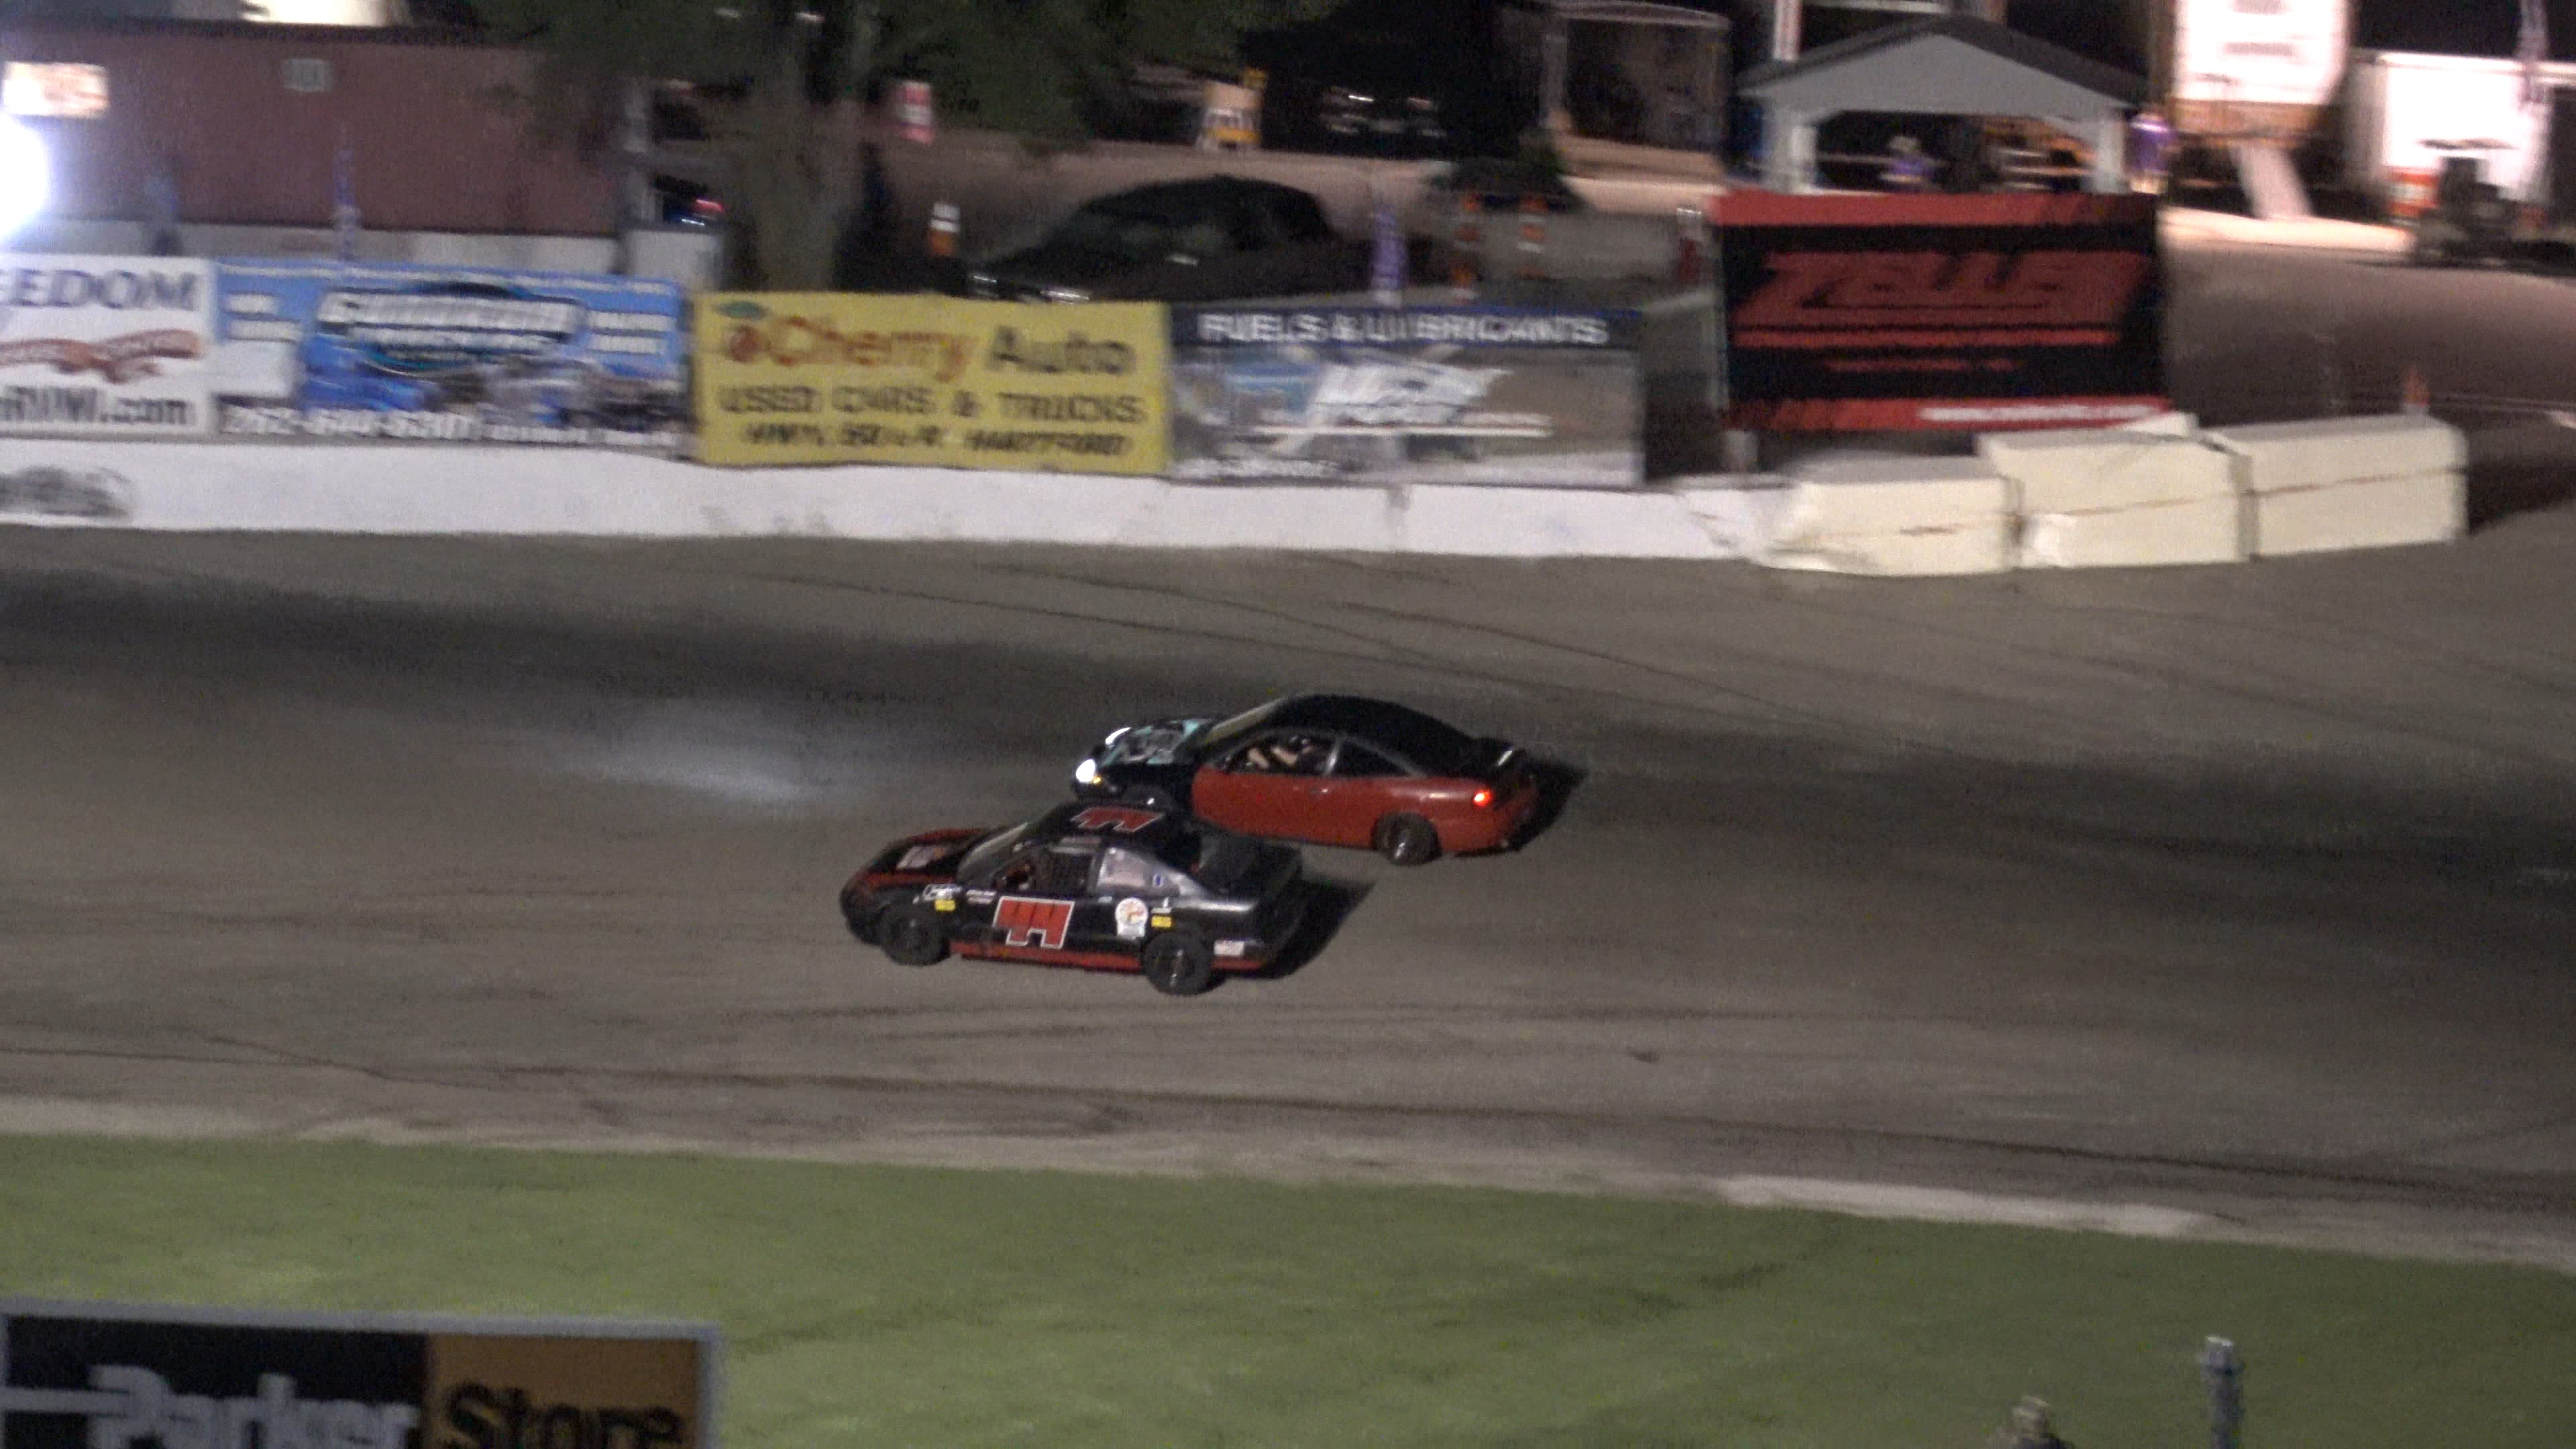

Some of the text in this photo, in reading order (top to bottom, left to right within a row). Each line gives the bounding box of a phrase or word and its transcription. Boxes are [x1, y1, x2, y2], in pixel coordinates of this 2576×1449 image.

[0, 266, 197, 312] EDOM
[767, 315, 1136, 383] Cherry Auto
[1198, 312, 1608, 344] FUELS & LUBRICANTS
[717, 386, 1148, 423] USED CARS & TRUCKS
[992, 895, 1075, 949] 44
[443, 1380, 687, 1449] Store
